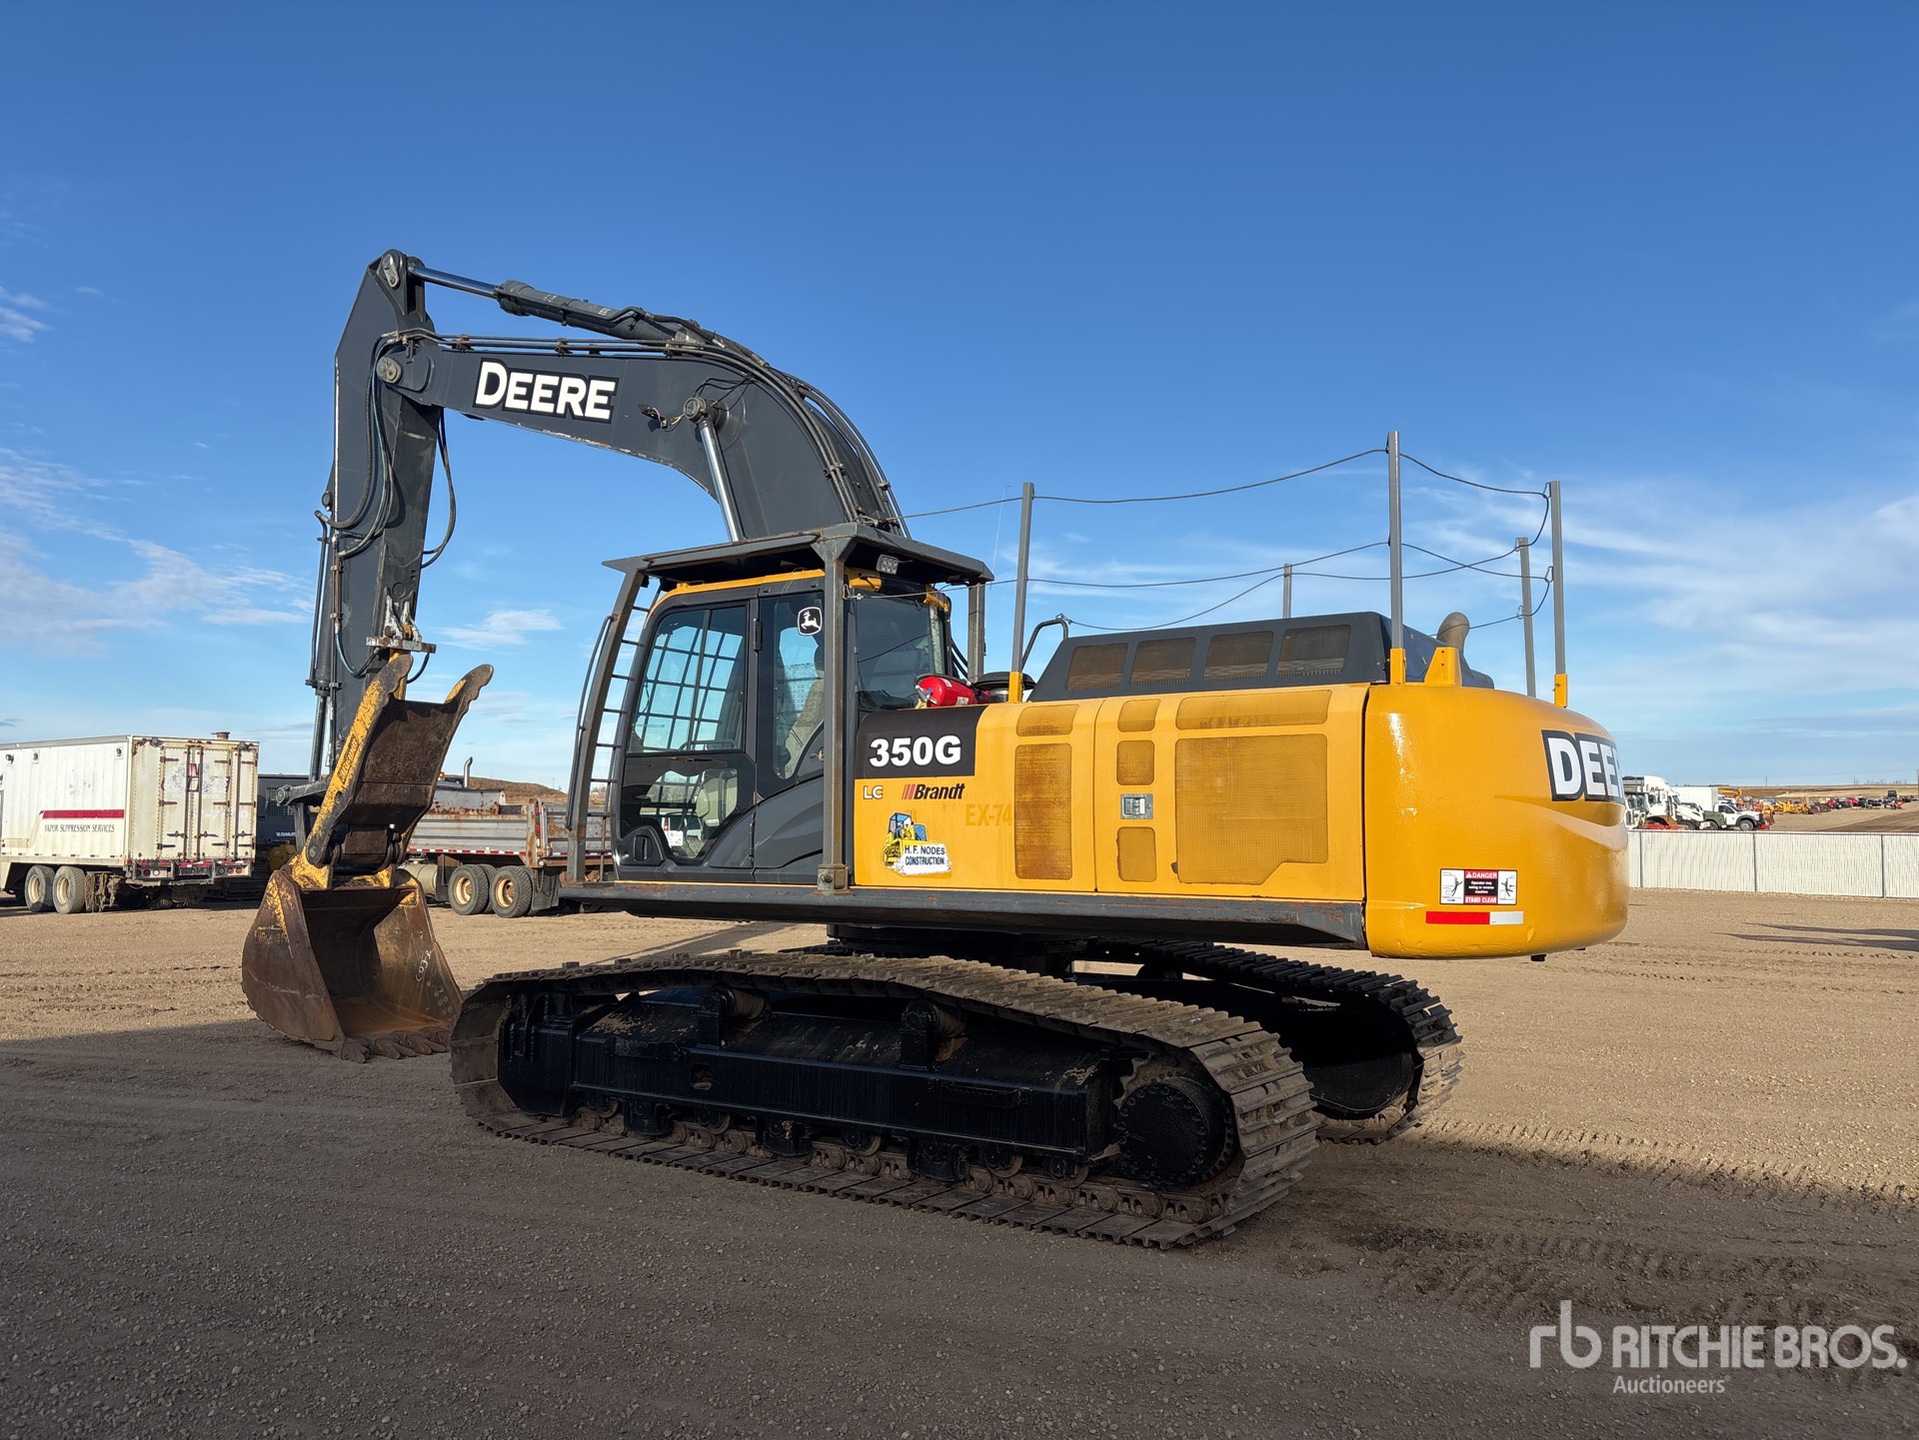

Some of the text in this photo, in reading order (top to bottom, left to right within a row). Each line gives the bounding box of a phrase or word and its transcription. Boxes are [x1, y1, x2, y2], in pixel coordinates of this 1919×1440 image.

[474, 360, 616, 420] DEERE
[868, 734, 962, 768] 350G
[863, 785, 884, 799] LC
[913, 783, 966, 800] Brandt
[44, 823, 115, 833] VAPOR SUPPRESSION SERVICES
[904, 844, 945, 855] H. F. NODES
[905, 856, 945, 866] CONSTRUCTION
[1472, 871, 1498, 879] DANGER
[1465, 896, 1497, 904] STAND CLEAR
